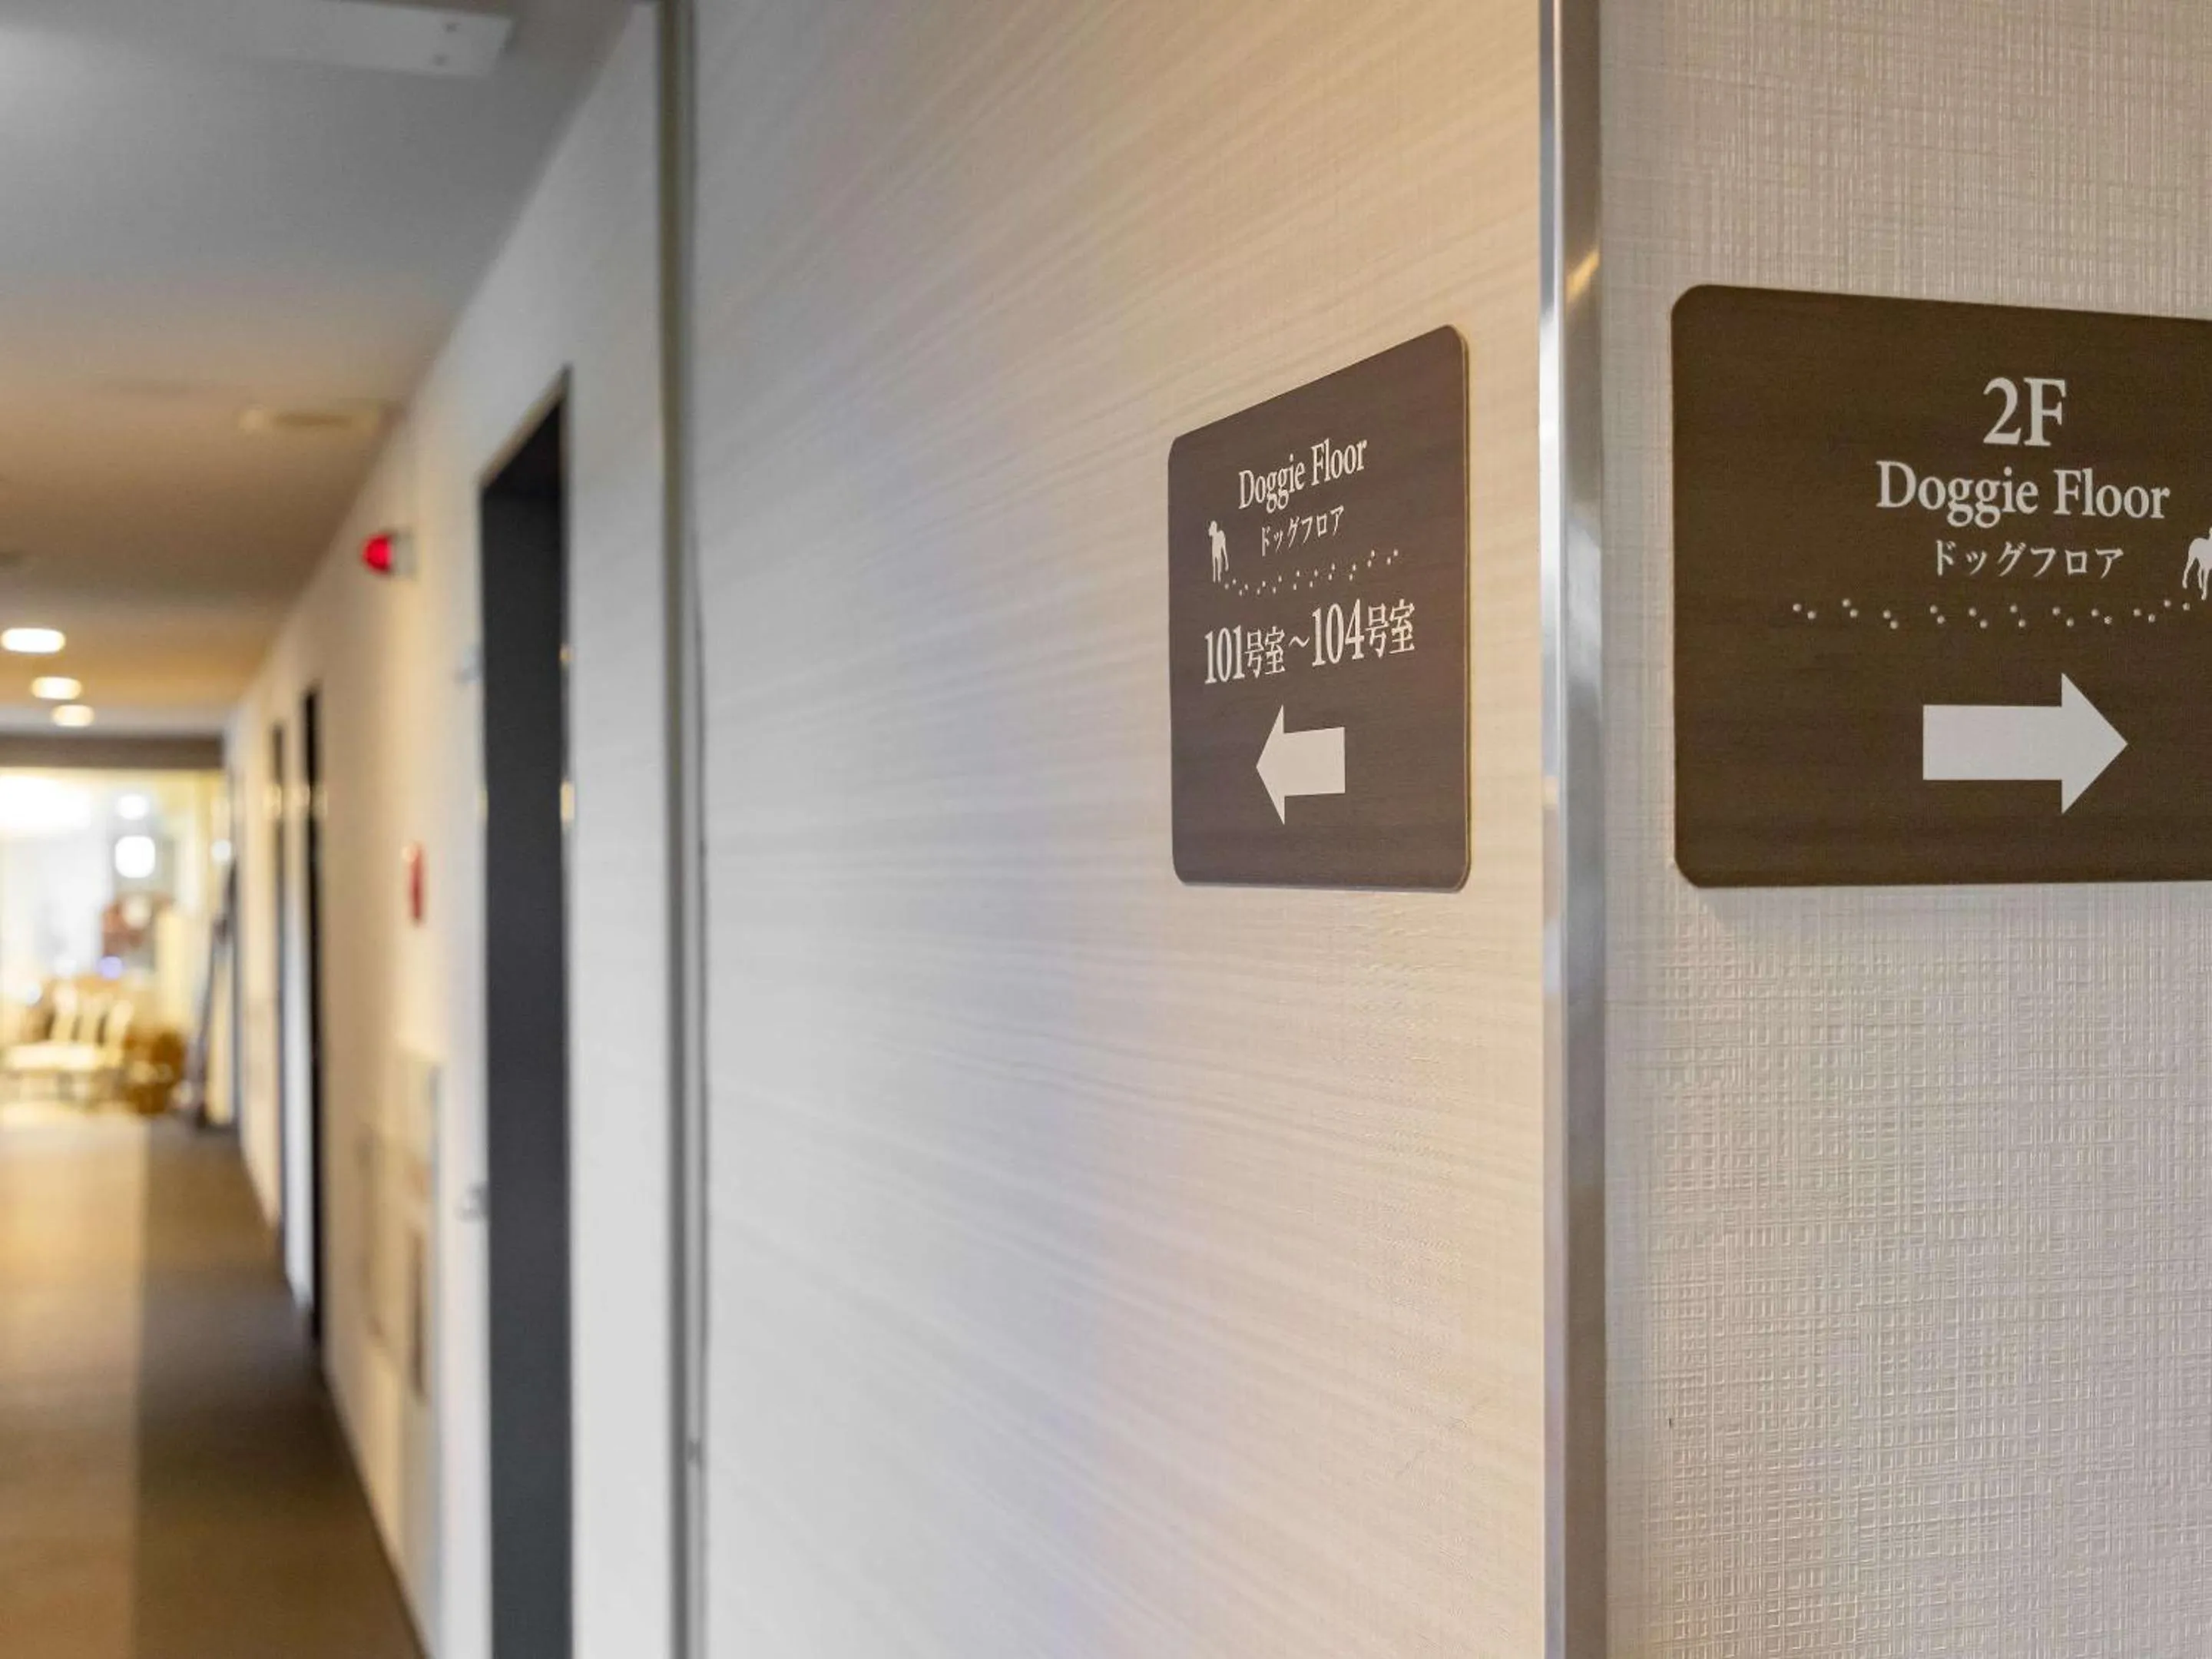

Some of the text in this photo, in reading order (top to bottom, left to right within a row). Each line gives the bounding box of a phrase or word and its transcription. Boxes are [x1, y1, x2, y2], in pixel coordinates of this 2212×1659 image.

[1983, 376, 2066, 446] 2F
[1238, 437, 1369, 514] Doggie Floor
[1876, 461, 2171, 528] Doggie Floor
[1260, 505, 1345, 558] ドッグフロア
[1936, 539, 2124, 578] ドッグフロア
